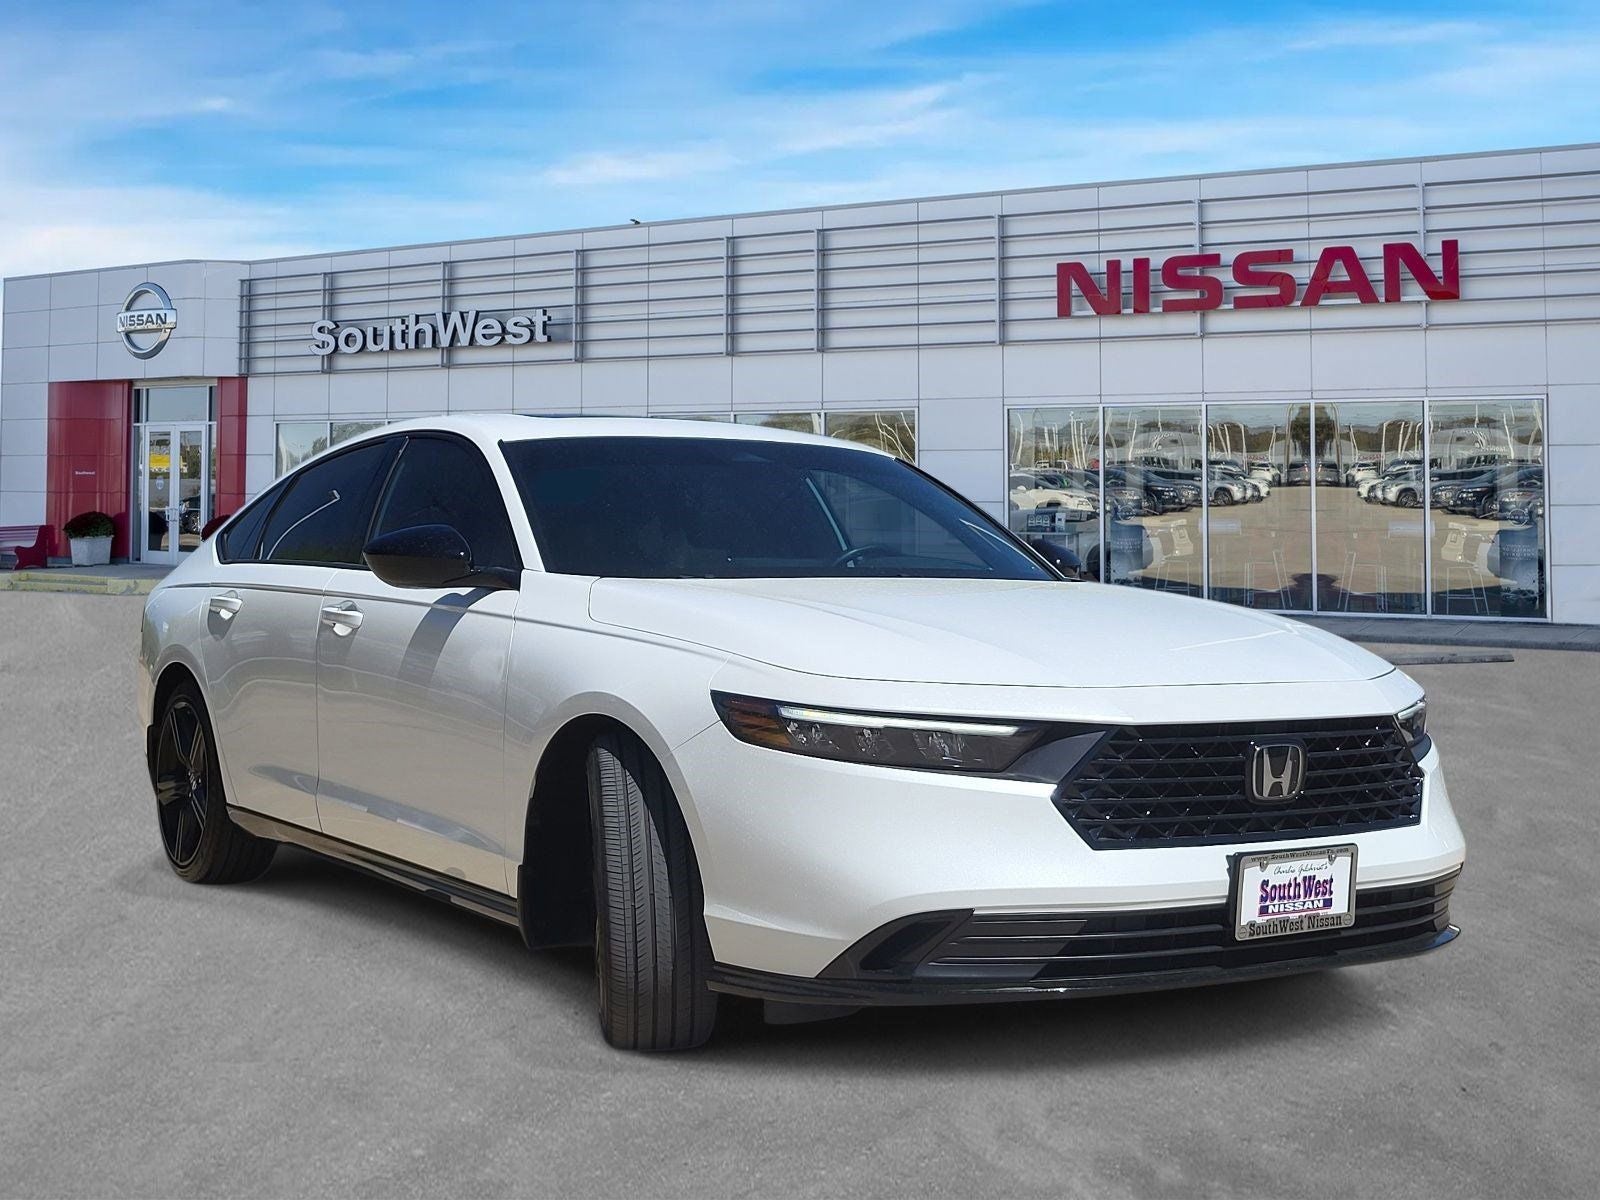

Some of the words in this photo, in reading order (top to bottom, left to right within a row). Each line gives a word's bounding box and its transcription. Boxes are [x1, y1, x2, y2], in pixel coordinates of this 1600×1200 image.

[1056, 239, 1461, 318] NISSAN
[118, 313, 167, 327] NISSAN
[309, 308, 552, 356] SouthWest
[1259, 873, 1334, 904] SouthWest
[1268, 899, 1324, 914] NISSAN
[1248, 917, 1304, 937] SouthWest
[1307, 915, 1342, 929] Nissan
